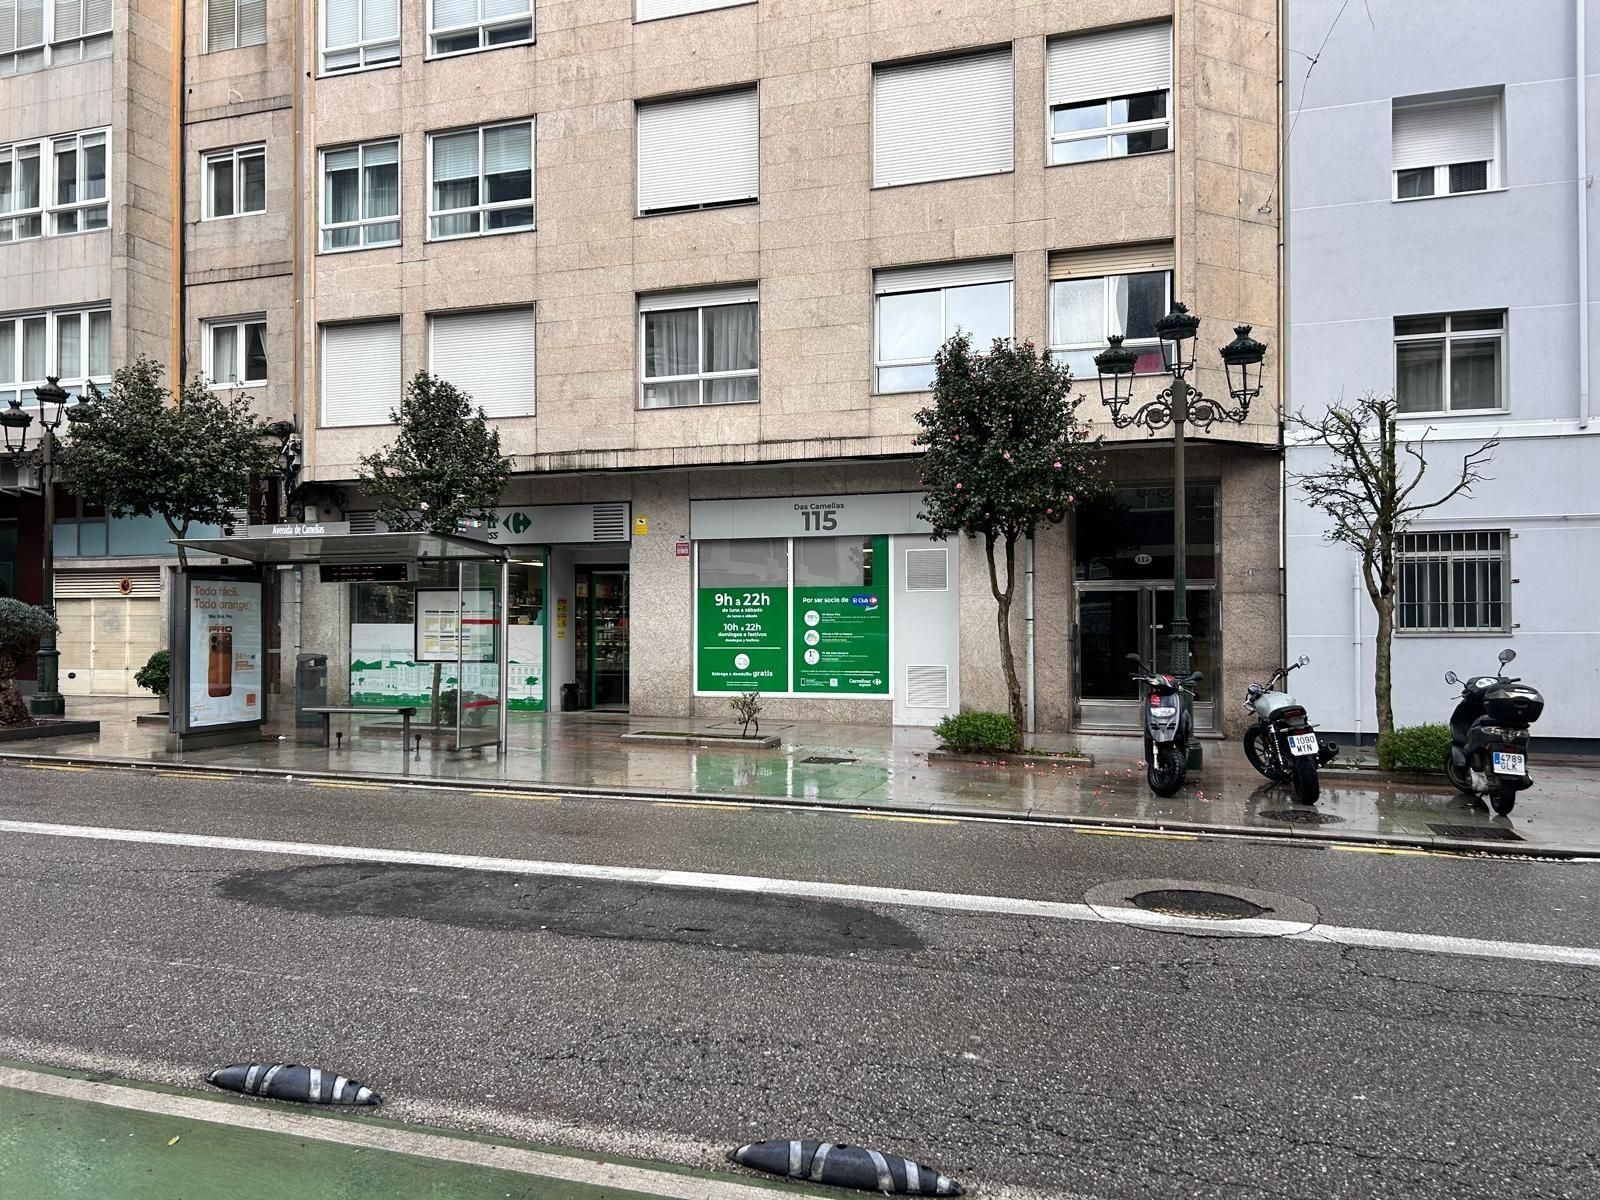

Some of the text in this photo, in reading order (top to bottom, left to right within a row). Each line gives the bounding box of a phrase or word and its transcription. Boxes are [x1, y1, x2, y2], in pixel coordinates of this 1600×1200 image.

[802, 510, 838, 531] 115
[272, 524, 324, 534] Avenida de Camelias
[194, 586, 240, 597] Todo fácil.
[714, 593, 732, 606] 9h
[742, 592, 770, 606] 22h
[194, 598, 249, 611] Todo orange
[723, 623, 738, 631] 10h
[745, 623, 761, 631] 22h
[1296, 736, 1315, 744] 1090
[1297, 744, 1313, 752] MYN
[1500, 754, 1522, 764] 4789
[1500, 762, 1517, 770] GLK
